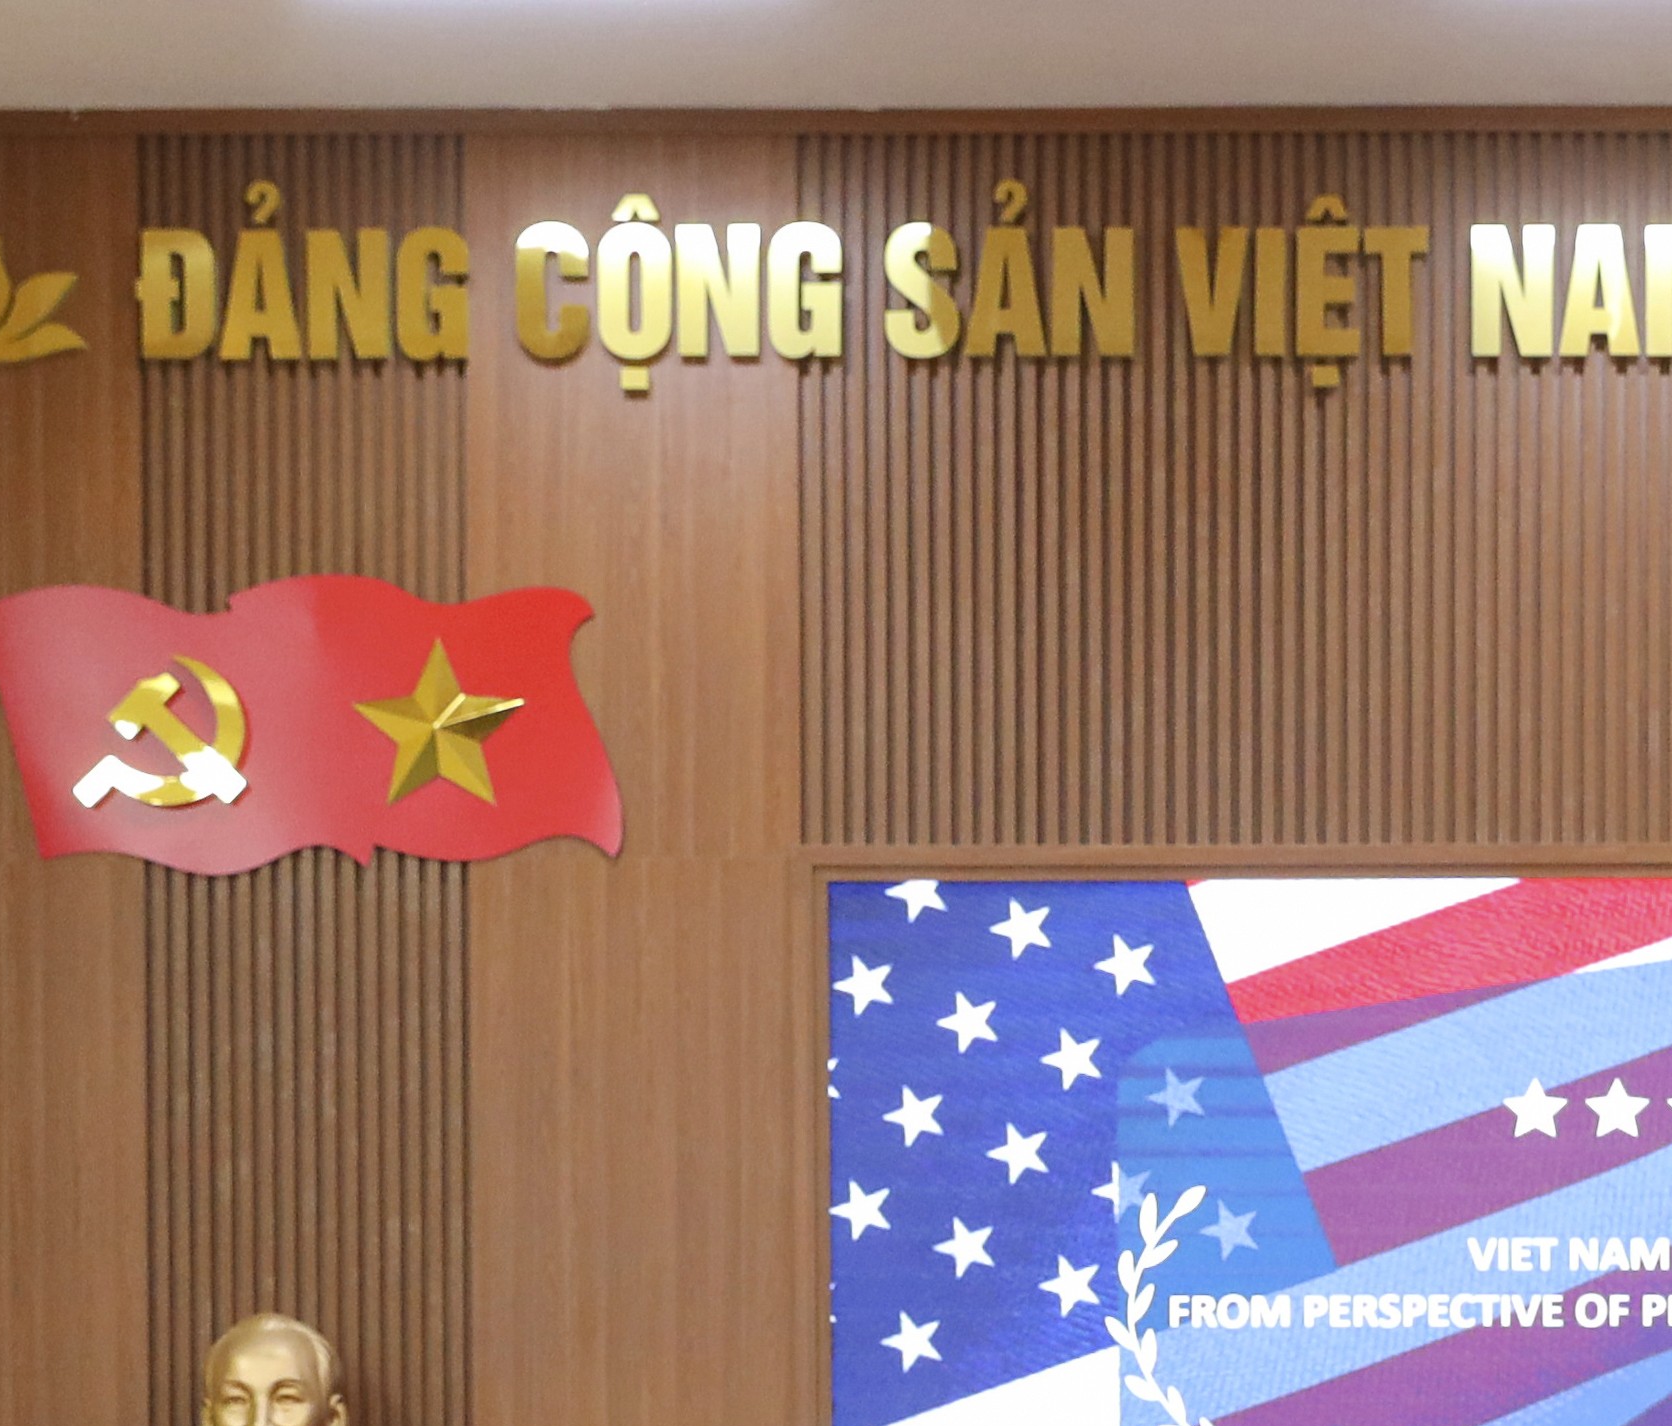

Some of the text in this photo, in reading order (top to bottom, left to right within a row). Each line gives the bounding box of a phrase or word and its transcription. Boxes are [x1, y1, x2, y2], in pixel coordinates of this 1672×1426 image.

[134, 180, 469, 361] ĐẢNG
[515, 193, 843, 391] CỘNG
[884, 180, 1133, 361] SẢN
[1176, 195, 1429, 388] VIỆT
[1467, 1237, 1558, 1271] VIET
[1569, 1237, 1670, 1271] NAM
[1168, 1294, 1291, 1329] FROM
[1304, 1294, 1563, 1329] PERSPECTIVE
[1575, 1294, 1630, 1328] OF
